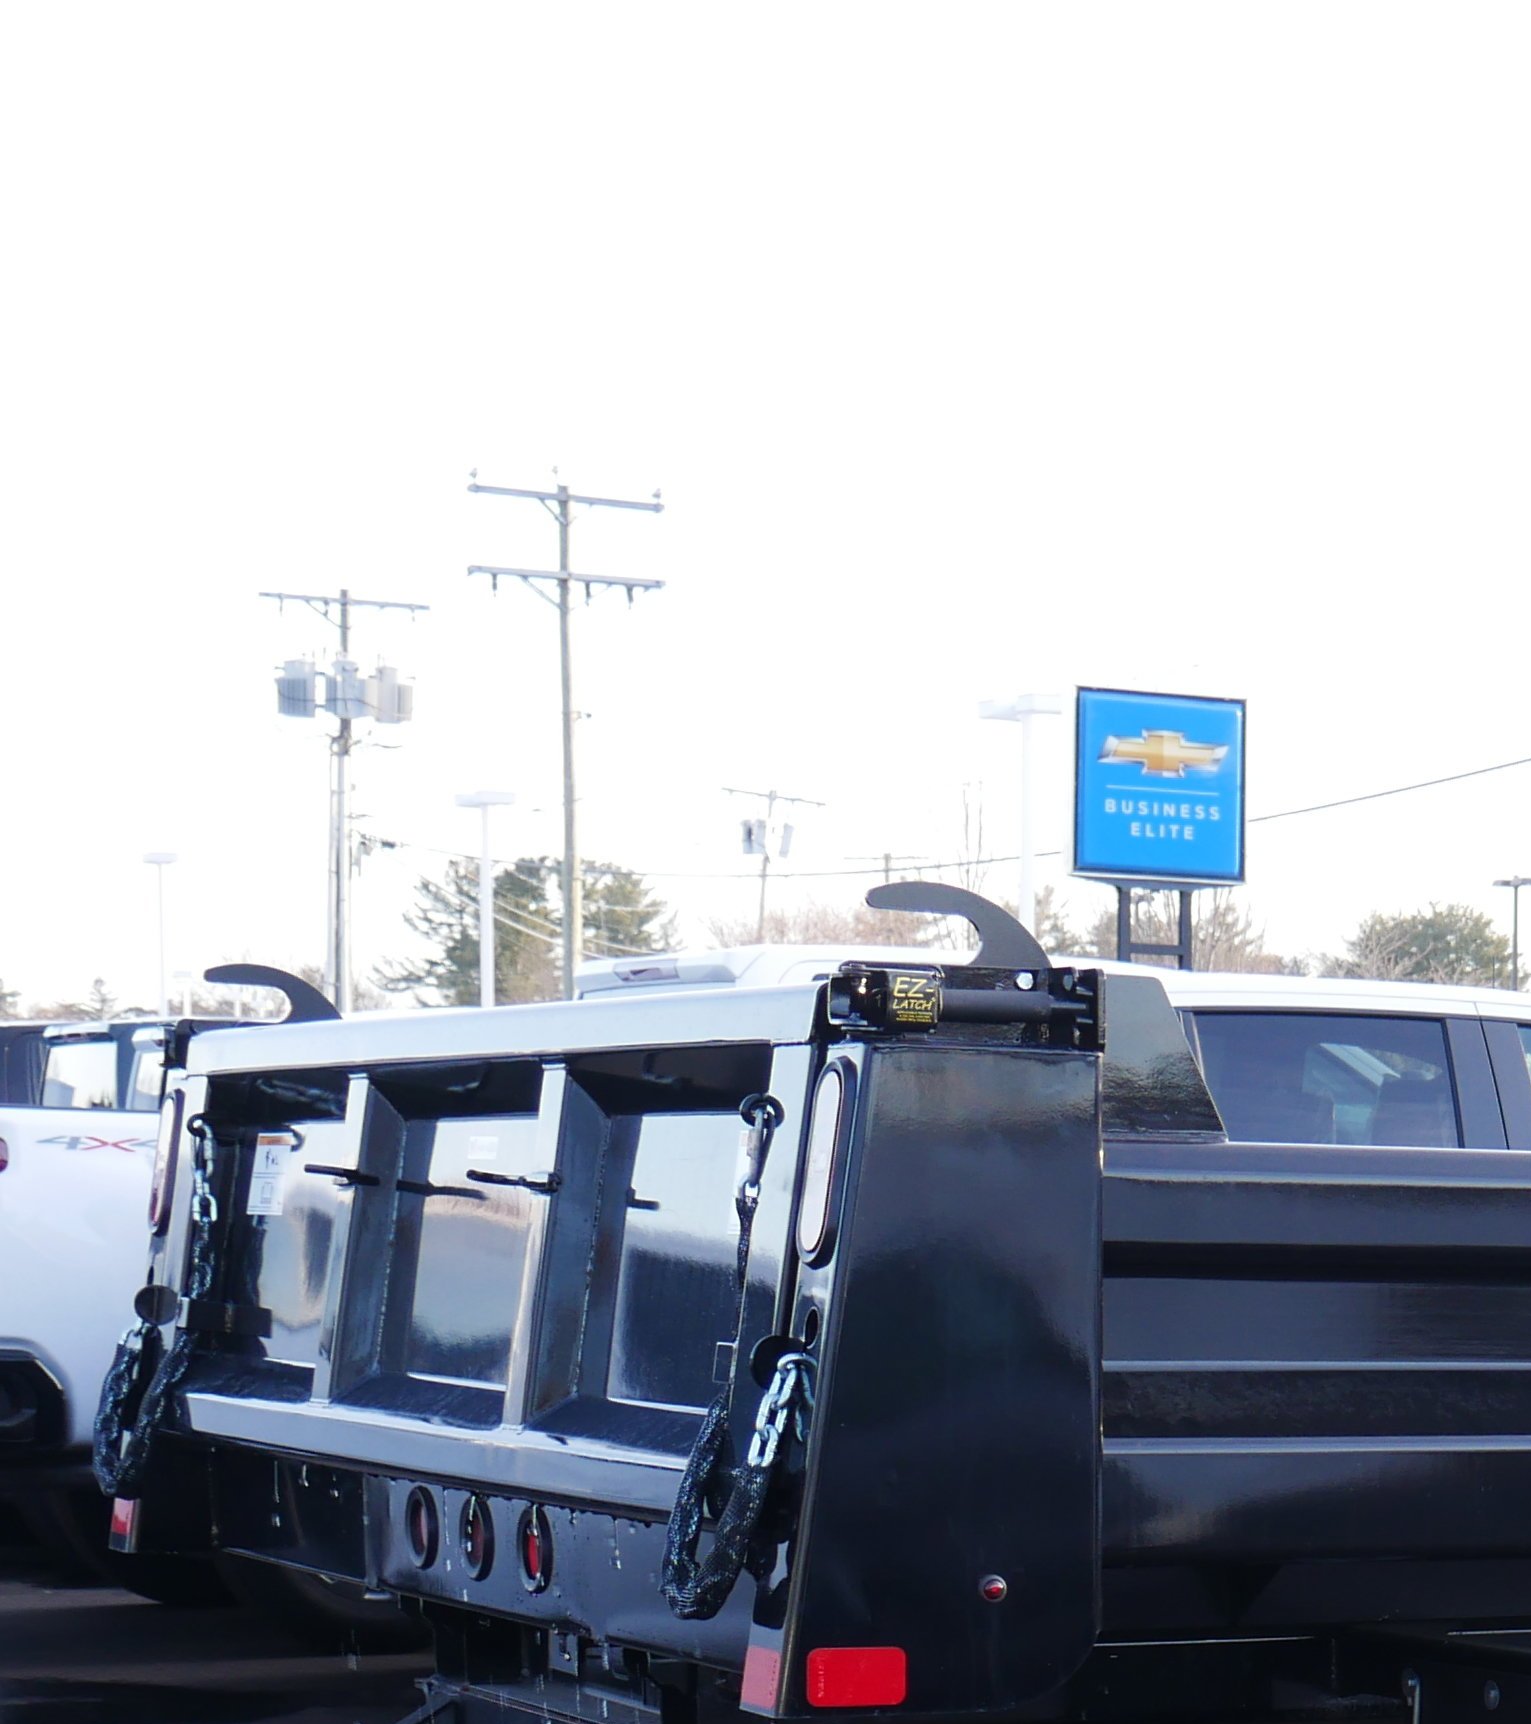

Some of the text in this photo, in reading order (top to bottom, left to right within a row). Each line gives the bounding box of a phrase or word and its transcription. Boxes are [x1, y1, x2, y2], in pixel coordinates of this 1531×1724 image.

[1104, 798, 1221, 821] BUSINESS
[1130, 822, 1194, 840] ELITE
[893, 976, 935, 998] EZ-
